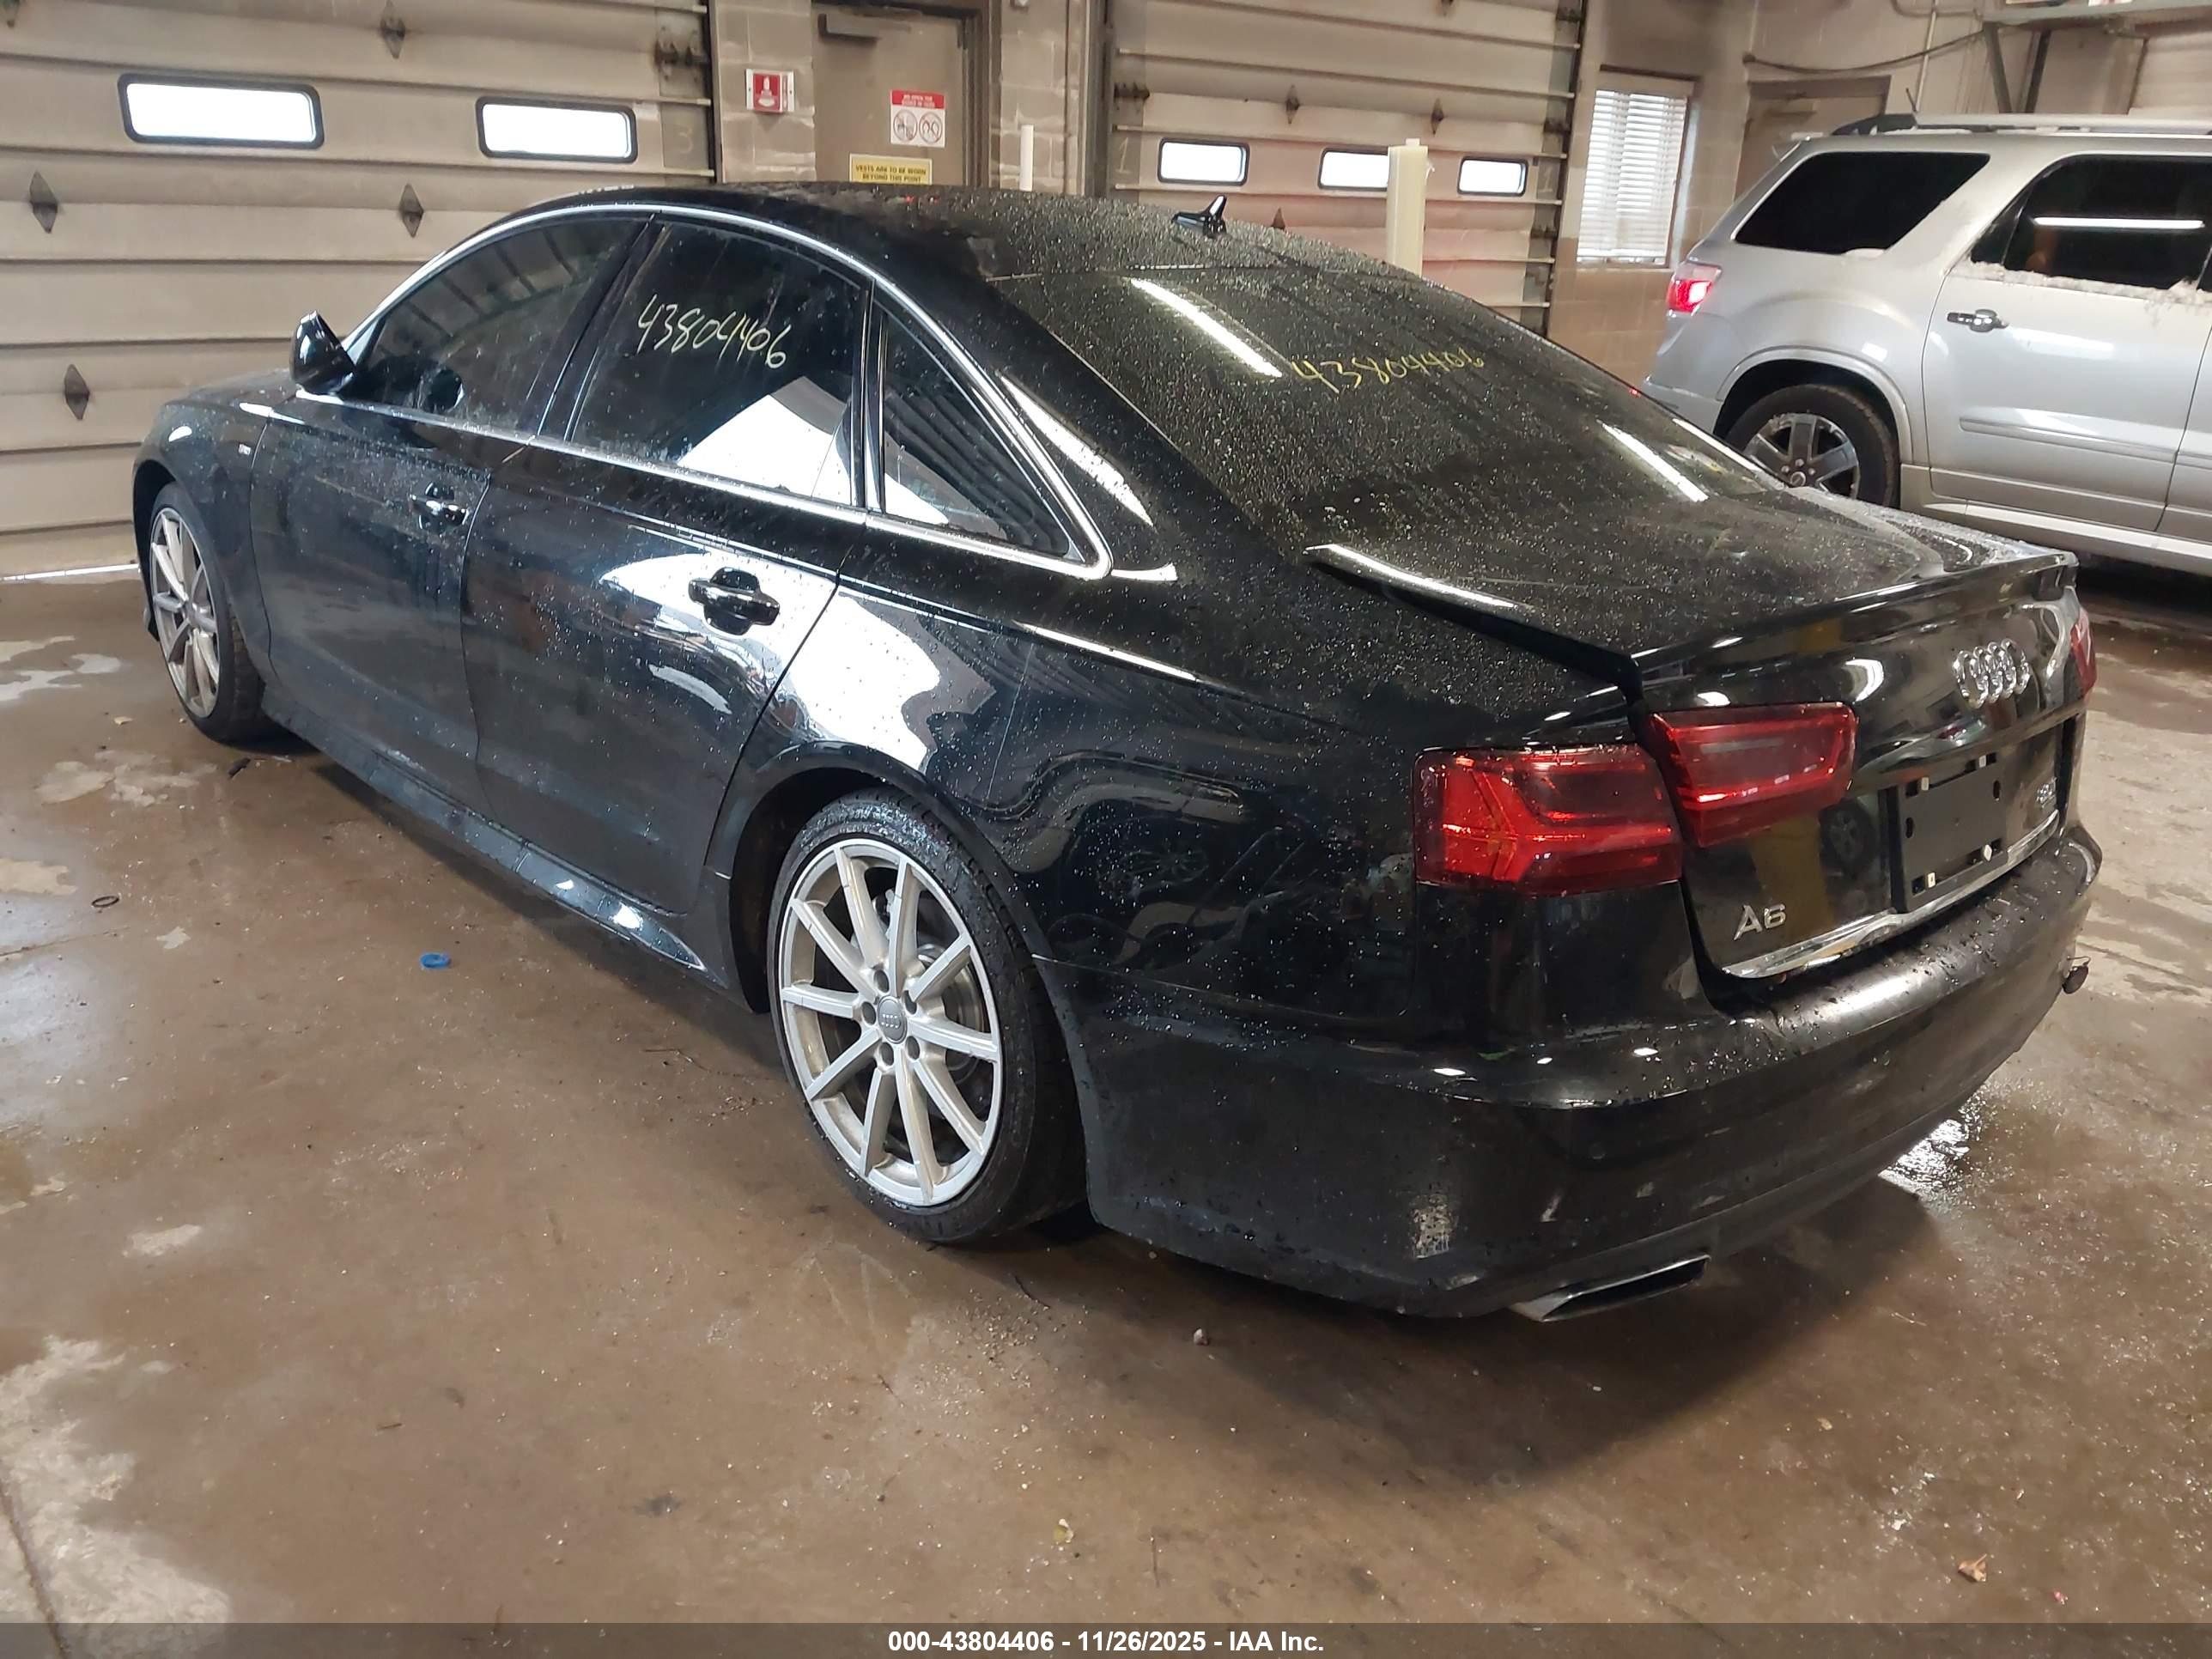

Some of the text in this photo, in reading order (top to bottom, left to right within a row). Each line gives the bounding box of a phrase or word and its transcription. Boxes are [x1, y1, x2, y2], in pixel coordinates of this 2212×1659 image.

[636, 294, 792, 369] 43804406
[1291, 347, 1485, 394] 43804406
[1733, 903, 1786, 941] A6
